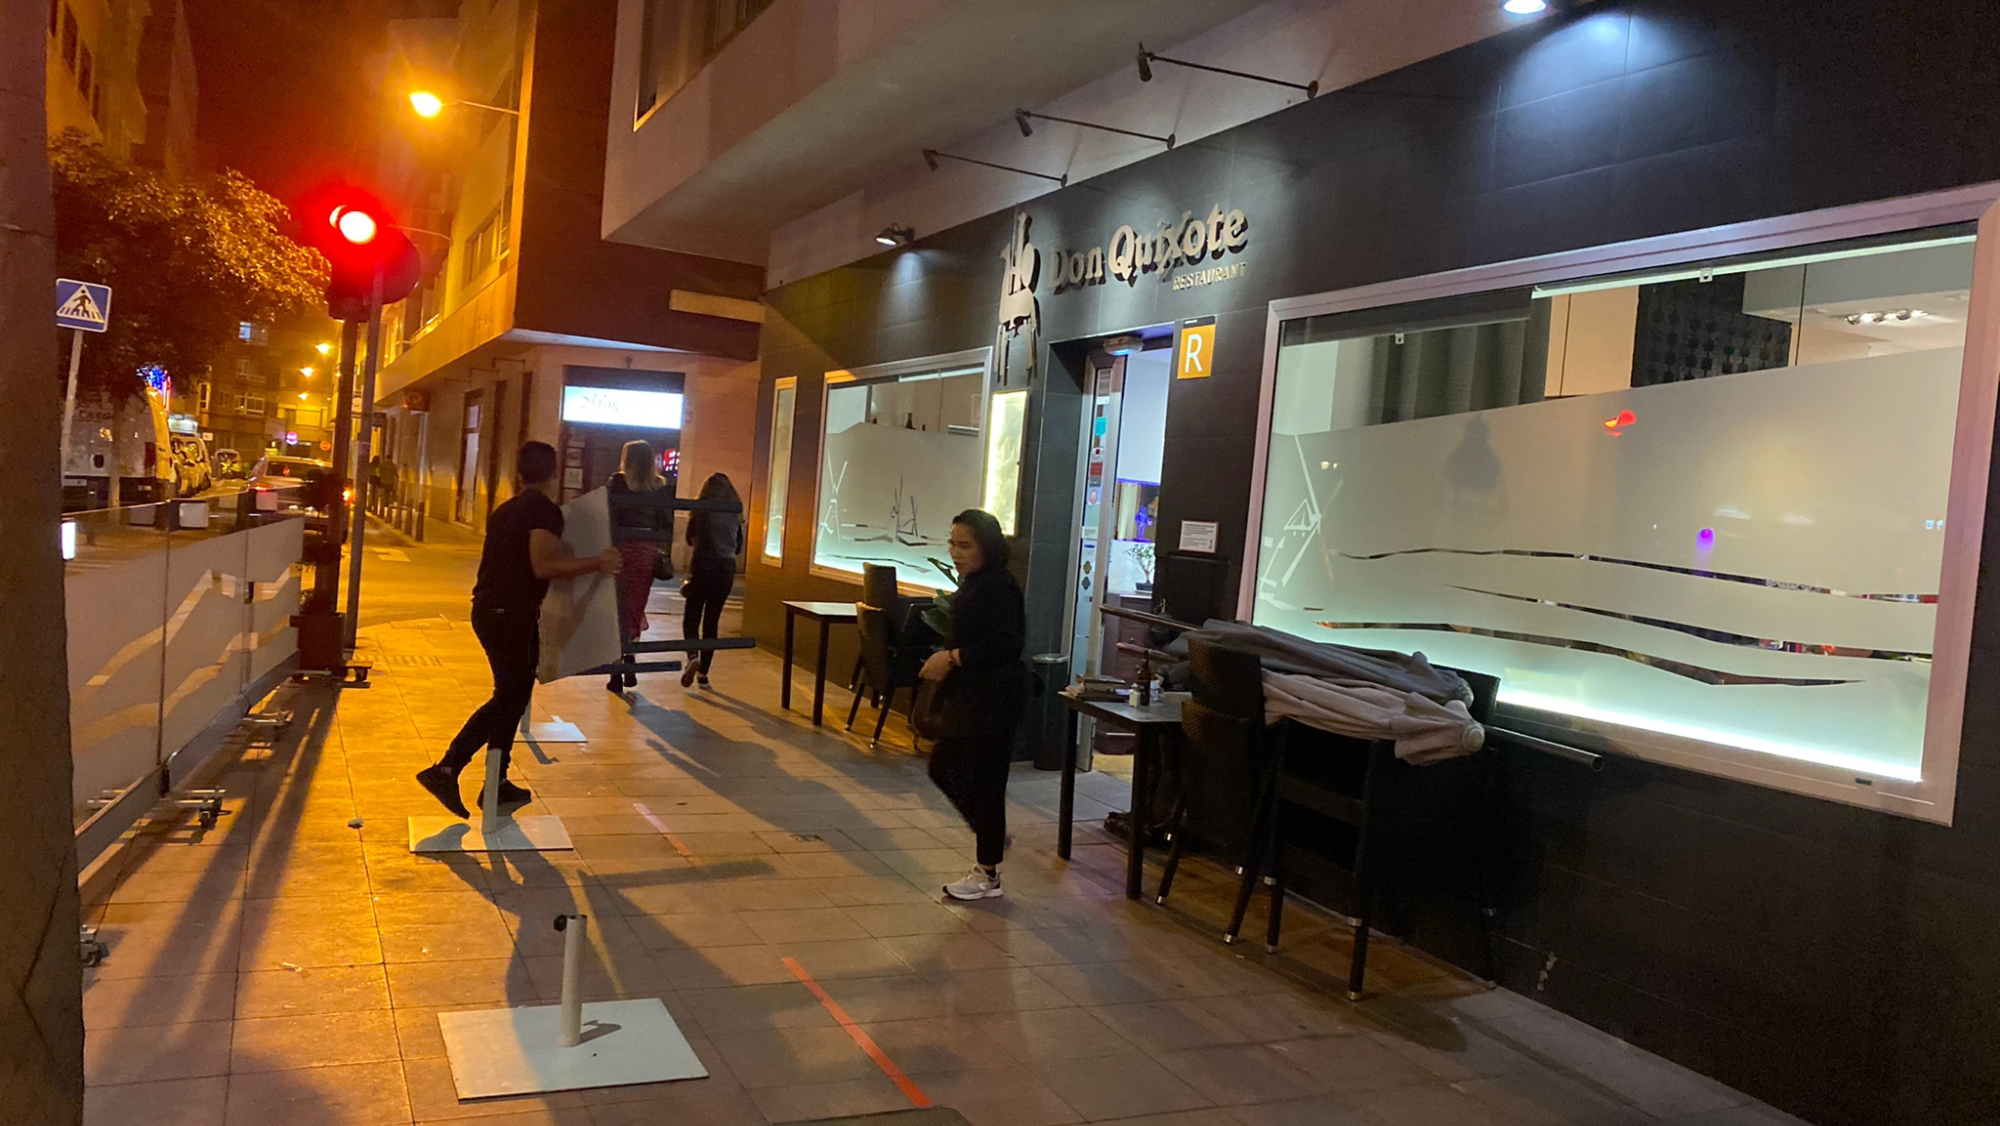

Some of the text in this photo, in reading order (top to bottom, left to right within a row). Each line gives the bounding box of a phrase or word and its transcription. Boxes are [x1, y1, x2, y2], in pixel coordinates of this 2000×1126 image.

[1047, 203, 1246, 289] Don Quixote
[1172, 262, 1248, 291] RESTAURANT
[1184, 333, 1203, 374] R
